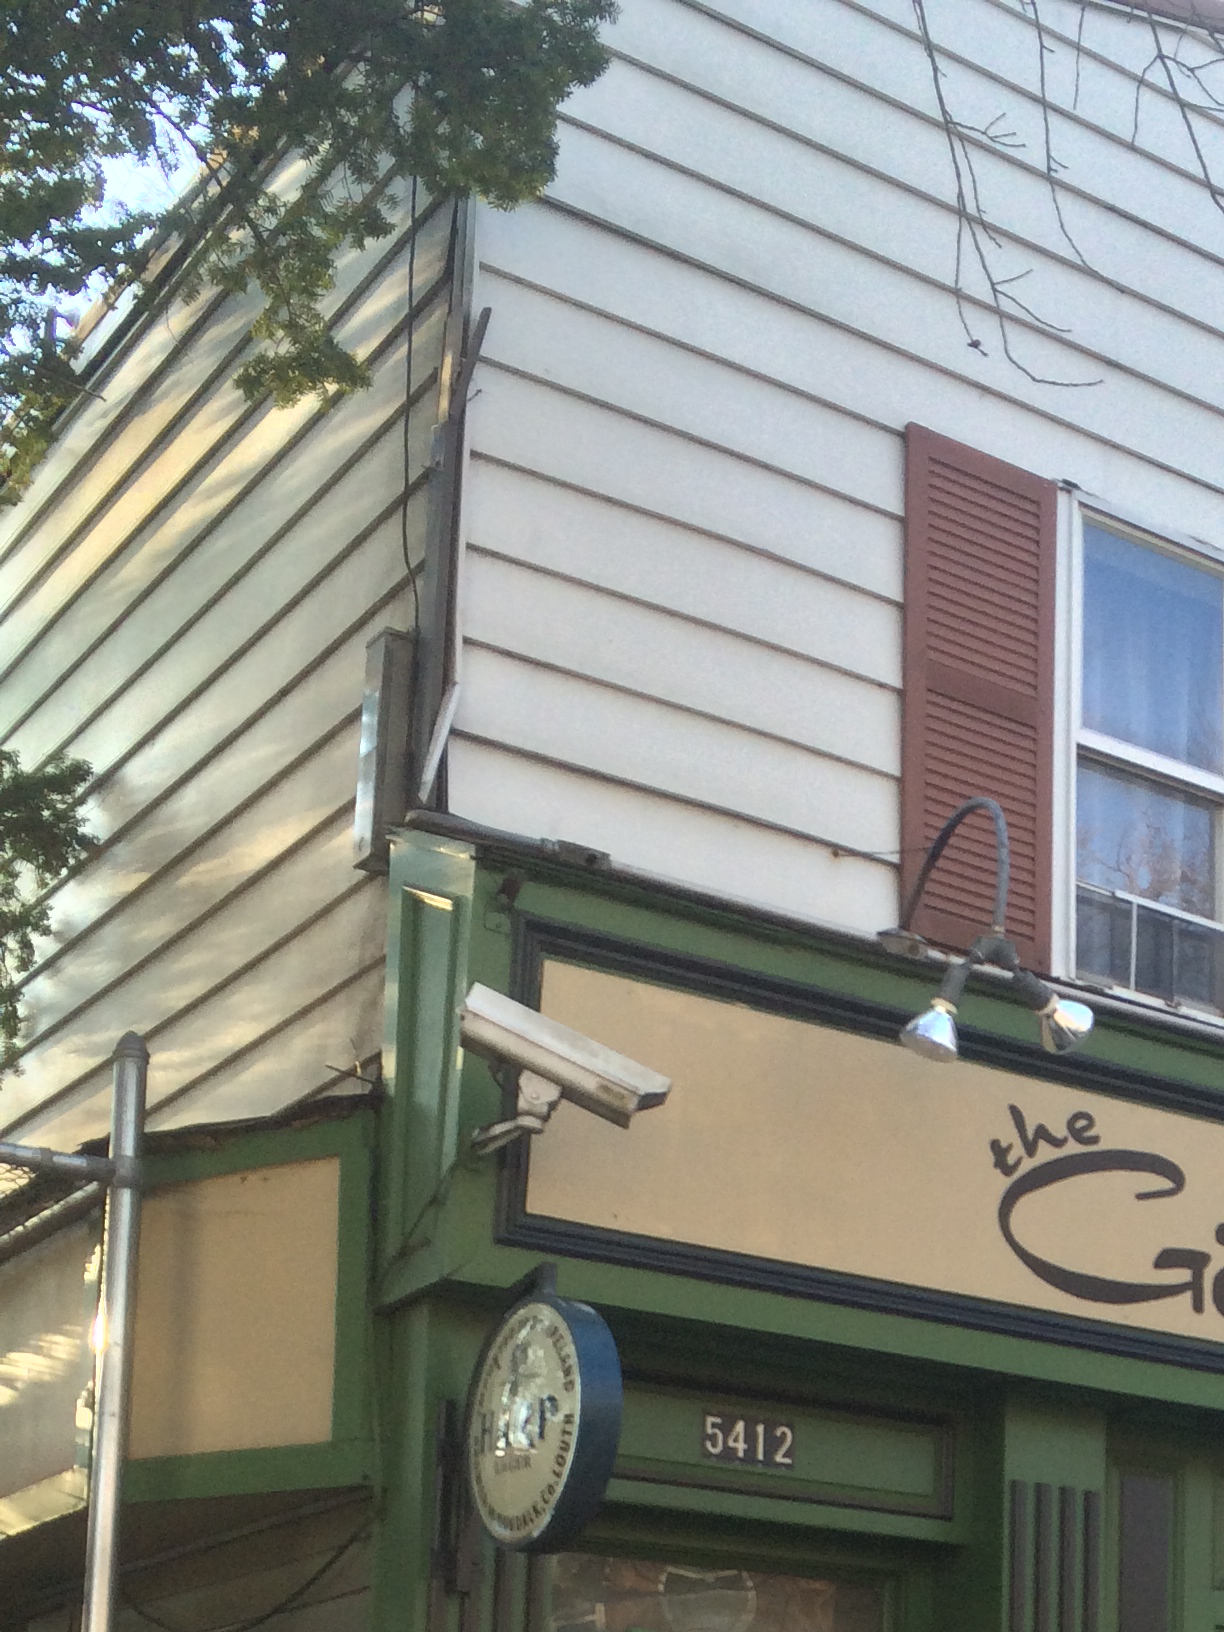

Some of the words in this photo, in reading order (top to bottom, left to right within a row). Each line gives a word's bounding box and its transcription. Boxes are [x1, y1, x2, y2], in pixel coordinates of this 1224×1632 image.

[989, 1103, 1100, 1177] the
[480, 1393, 559, 1454] HRP
[552, 1412, 576, 1480] LOUTH
[704, 1413, 794, 1465] 5412
